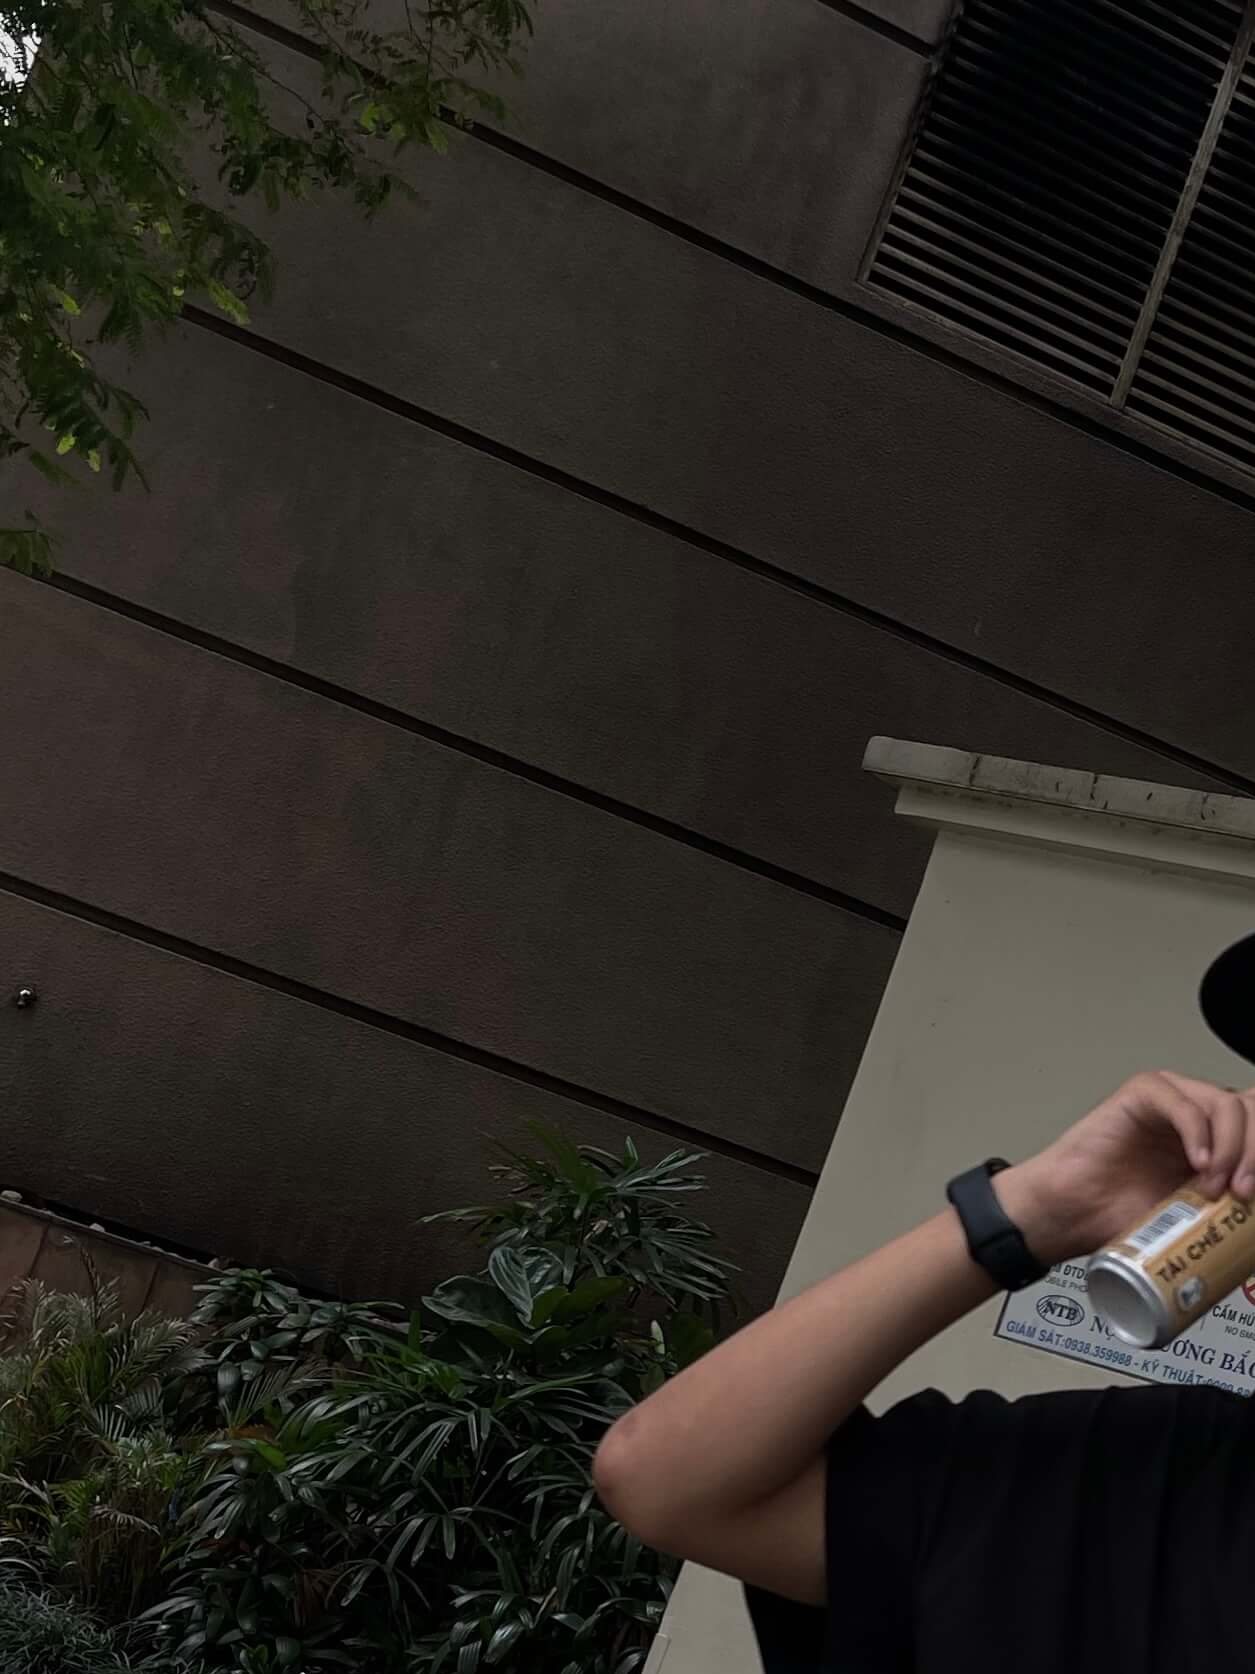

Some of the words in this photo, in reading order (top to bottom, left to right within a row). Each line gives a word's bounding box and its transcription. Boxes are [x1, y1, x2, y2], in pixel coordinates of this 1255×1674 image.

[1043, 1301, 1078, 1321] NTB
[1212, 1303, 1238, 1322] CẤM
[1006, 1318, 1036, 1338] GIÁM
[1224, 1325, 1239, 1336] NO
